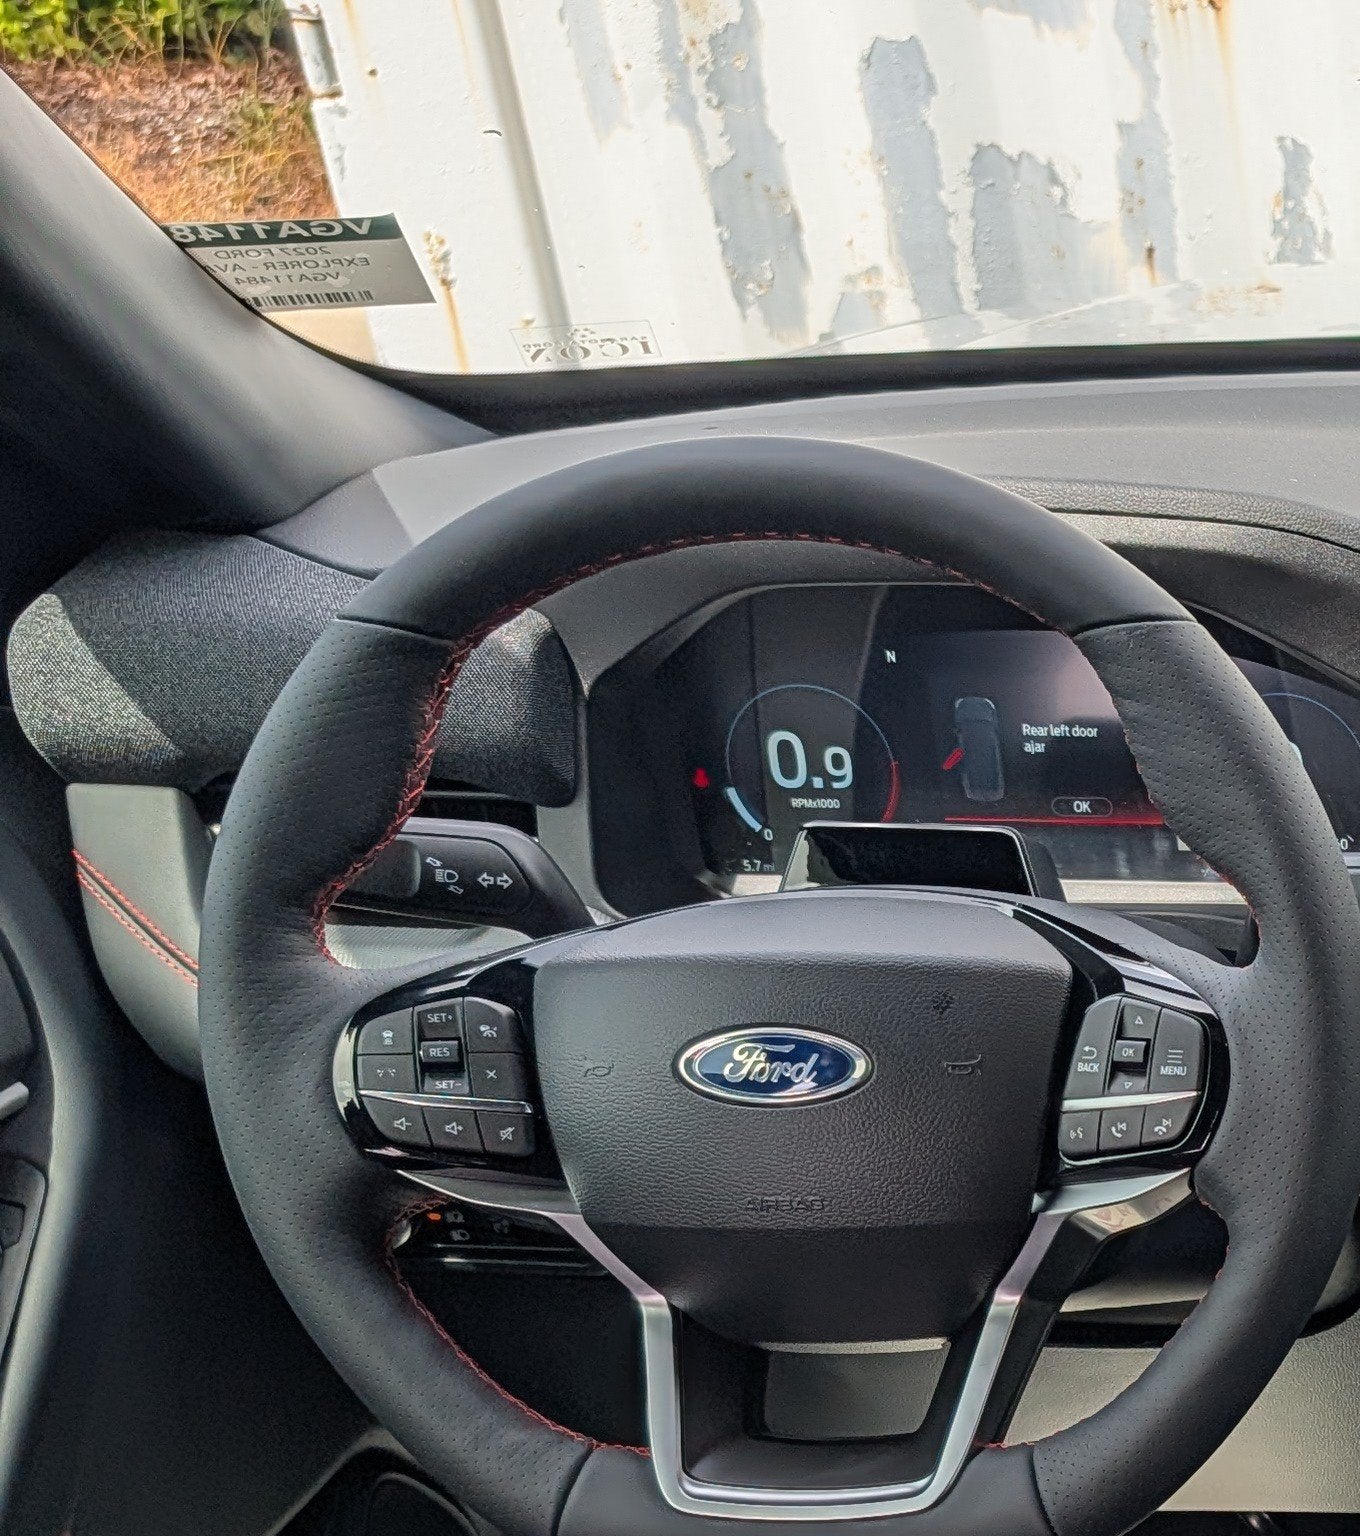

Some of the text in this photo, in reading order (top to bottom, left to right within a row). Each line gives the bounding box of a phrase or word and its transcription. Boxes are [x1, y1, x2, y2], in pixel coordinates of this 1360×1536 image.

[884, 649, 897, 664] N
[1022, 724, 1098, 738] Rear left door
[1024, 740, 1046, 756] ajar
[767, 730, 853, 789] 0.9
[791, 797, 841, 809] RPMx1000
[1073, 800, 1092, 814] OK
[763, 828, 774, 842] 0
[742, 858, 776, 872] 5.7 mi
[429, 1047, 451, 1057] RES
[1122, 1047, 1135, 1058] OK
[723, 1042, 820, 1084] Ford
[1077, 1062, 1100, 1073] BACK
[1160, 1065, 1187, 1077] MENU
